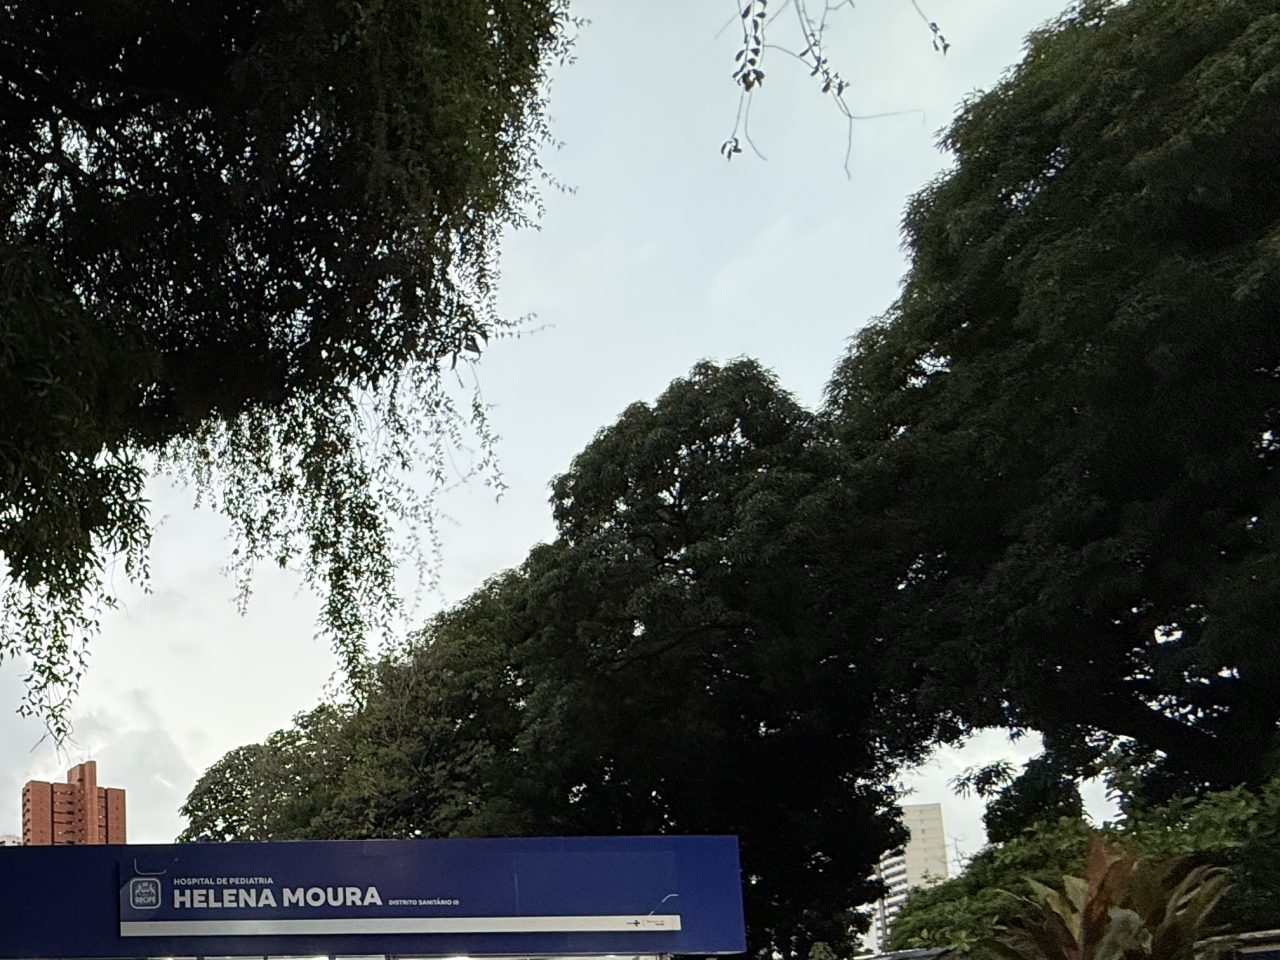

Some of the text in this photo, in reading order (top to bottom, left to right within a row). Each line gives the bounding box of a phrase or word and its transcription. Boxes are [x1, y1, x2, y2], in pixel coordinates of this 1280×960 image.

[173, 878, 215, 886] HOSPITAL
[229, 877, 274, 885] PEDIATRIA
[173, 886, 383, 909] HELENA MOURA
[418, 897, 452, 906] SANITÁRIO
